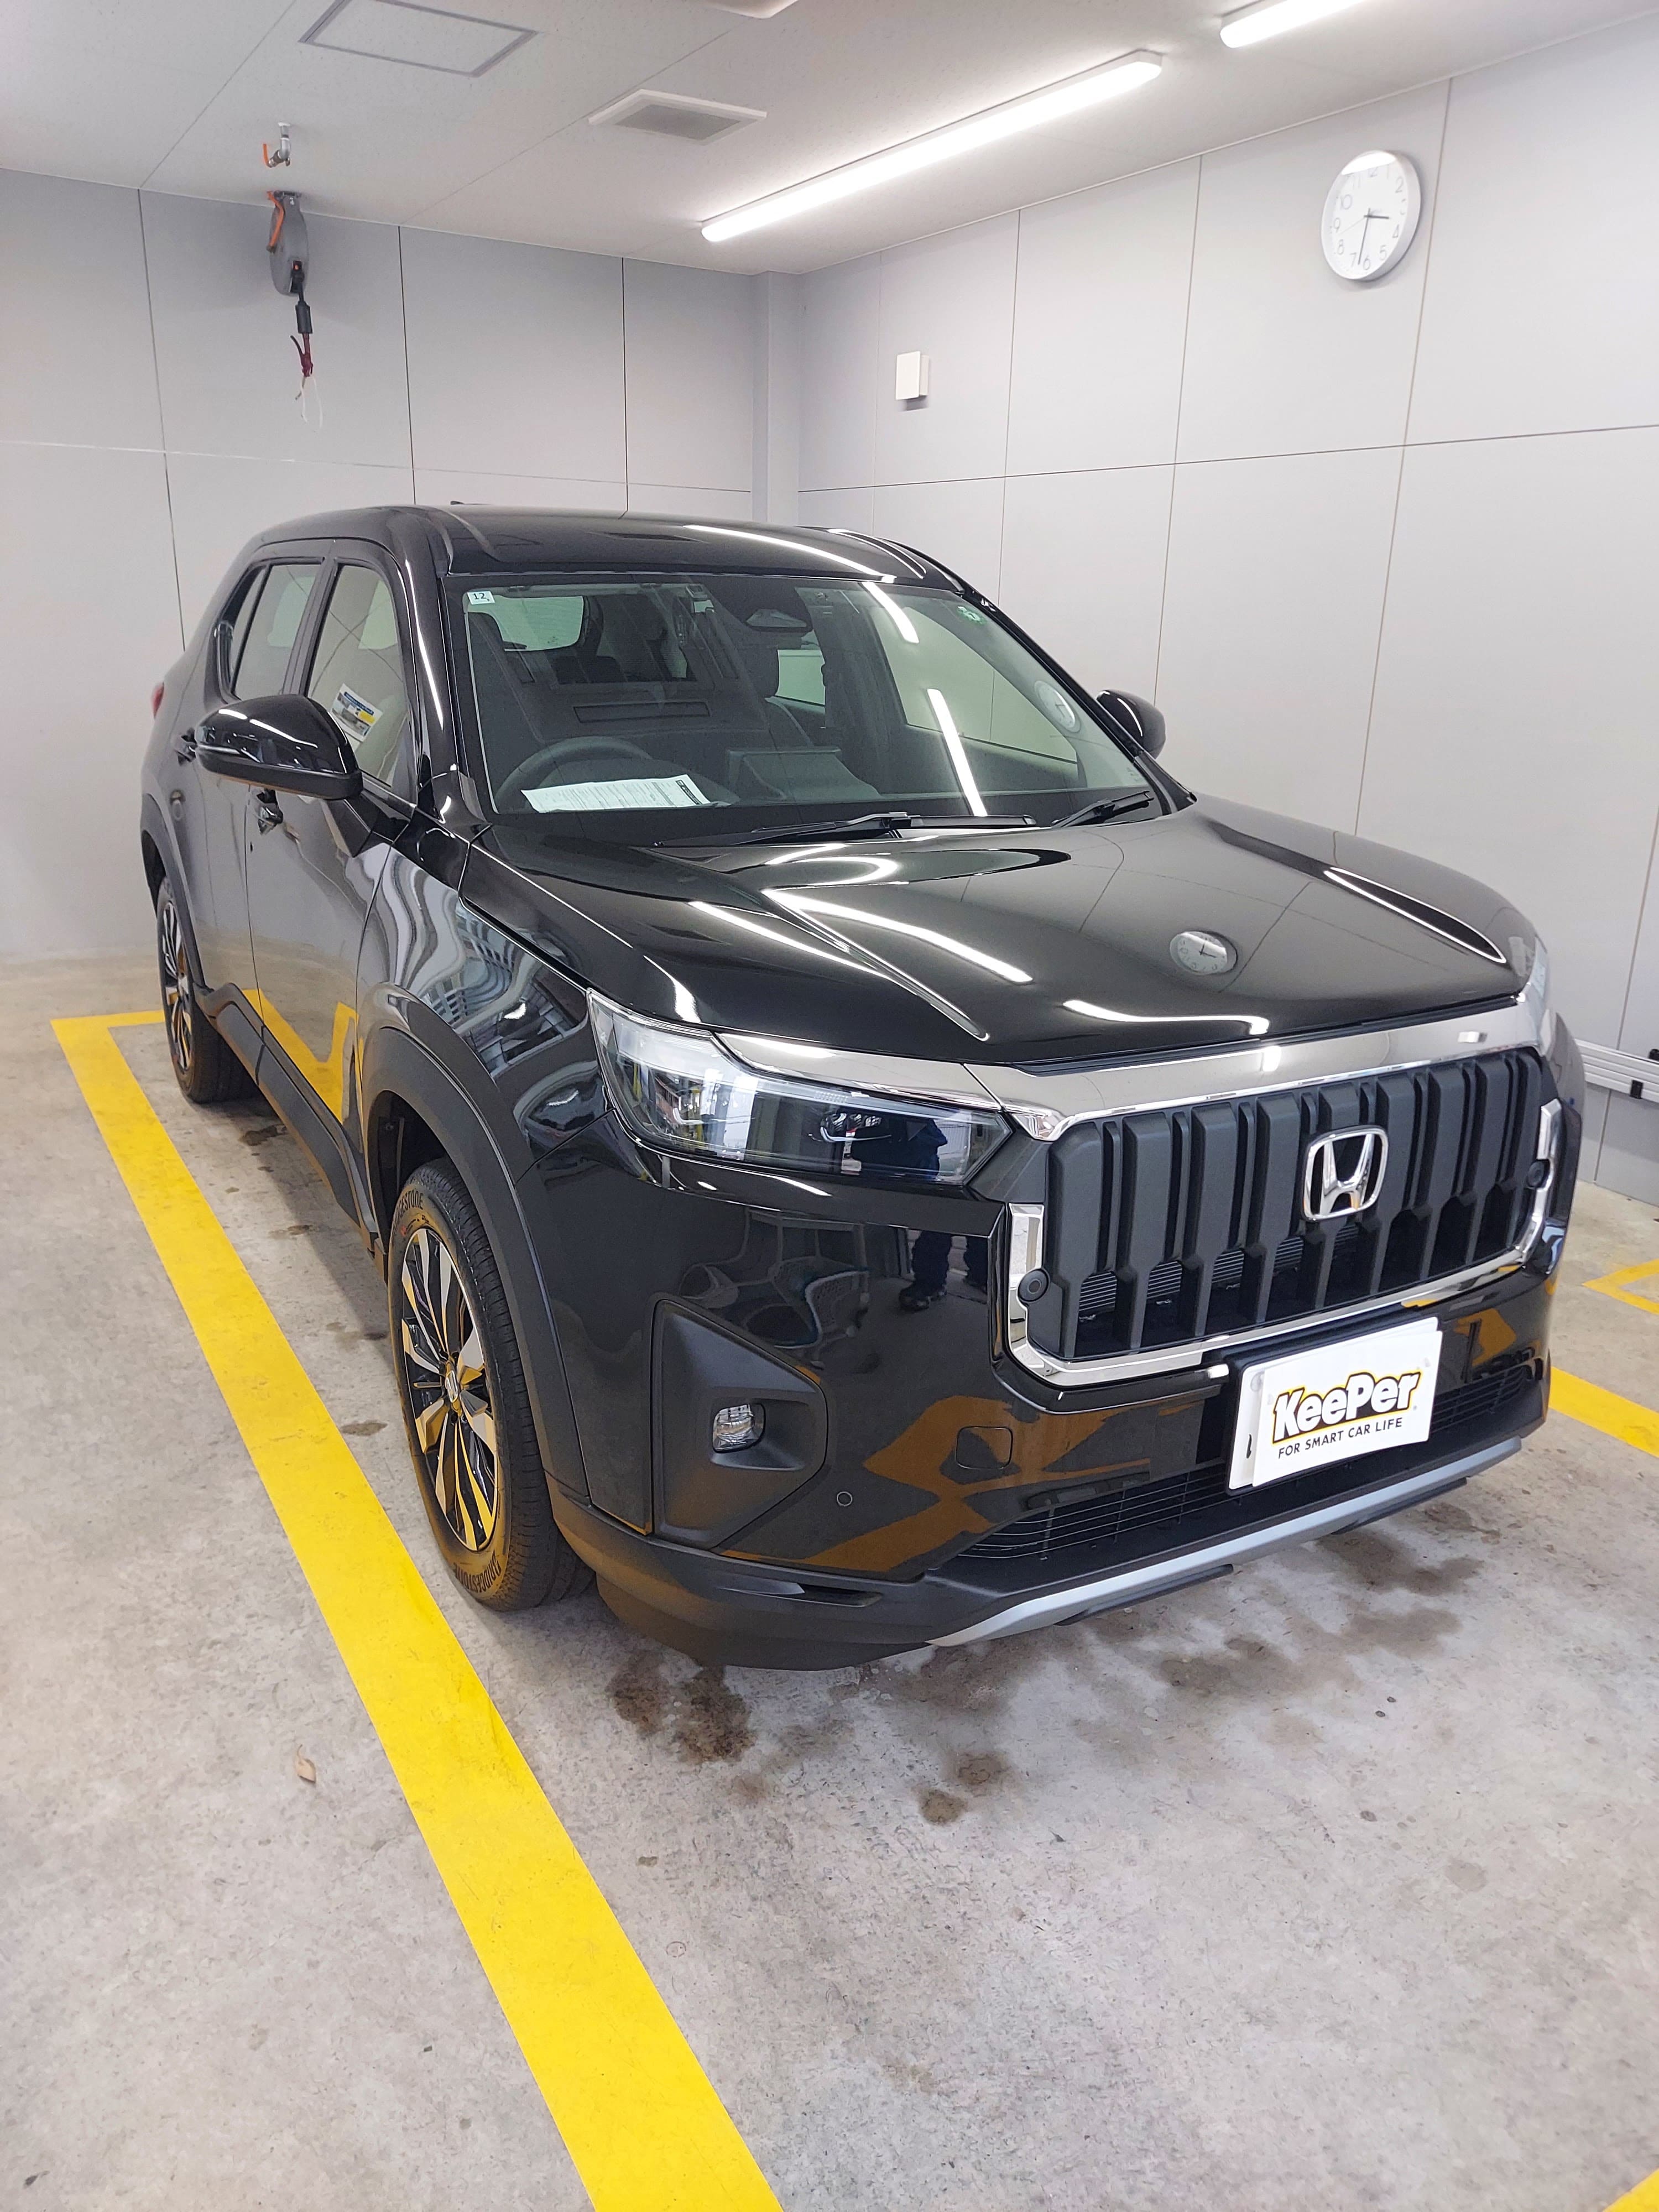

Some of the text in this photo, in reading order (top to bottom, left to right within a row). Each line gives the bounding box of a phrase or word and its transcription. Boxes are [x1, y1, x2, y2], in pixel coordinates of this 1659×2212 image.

[1395, 176, 1404, 193] 2
[1340, 194, 1353, 210] 10
[1333, 217, 1341, 233] 9
[1392, 224, 1400, 238] 4
[1337, 239, 1344, 255] 8
[1379, 244, 1387, 260] 5
[1349, 252, 1357, 268] 7
[1362, 255, 1371, 270] 6
[391, 1188, 424, 1235] IDGESTONE
[1272, 1372, 1421, 1443] KeePer
[1278, 1417, 1402, 1459] FOR SMART CAR LIFE
